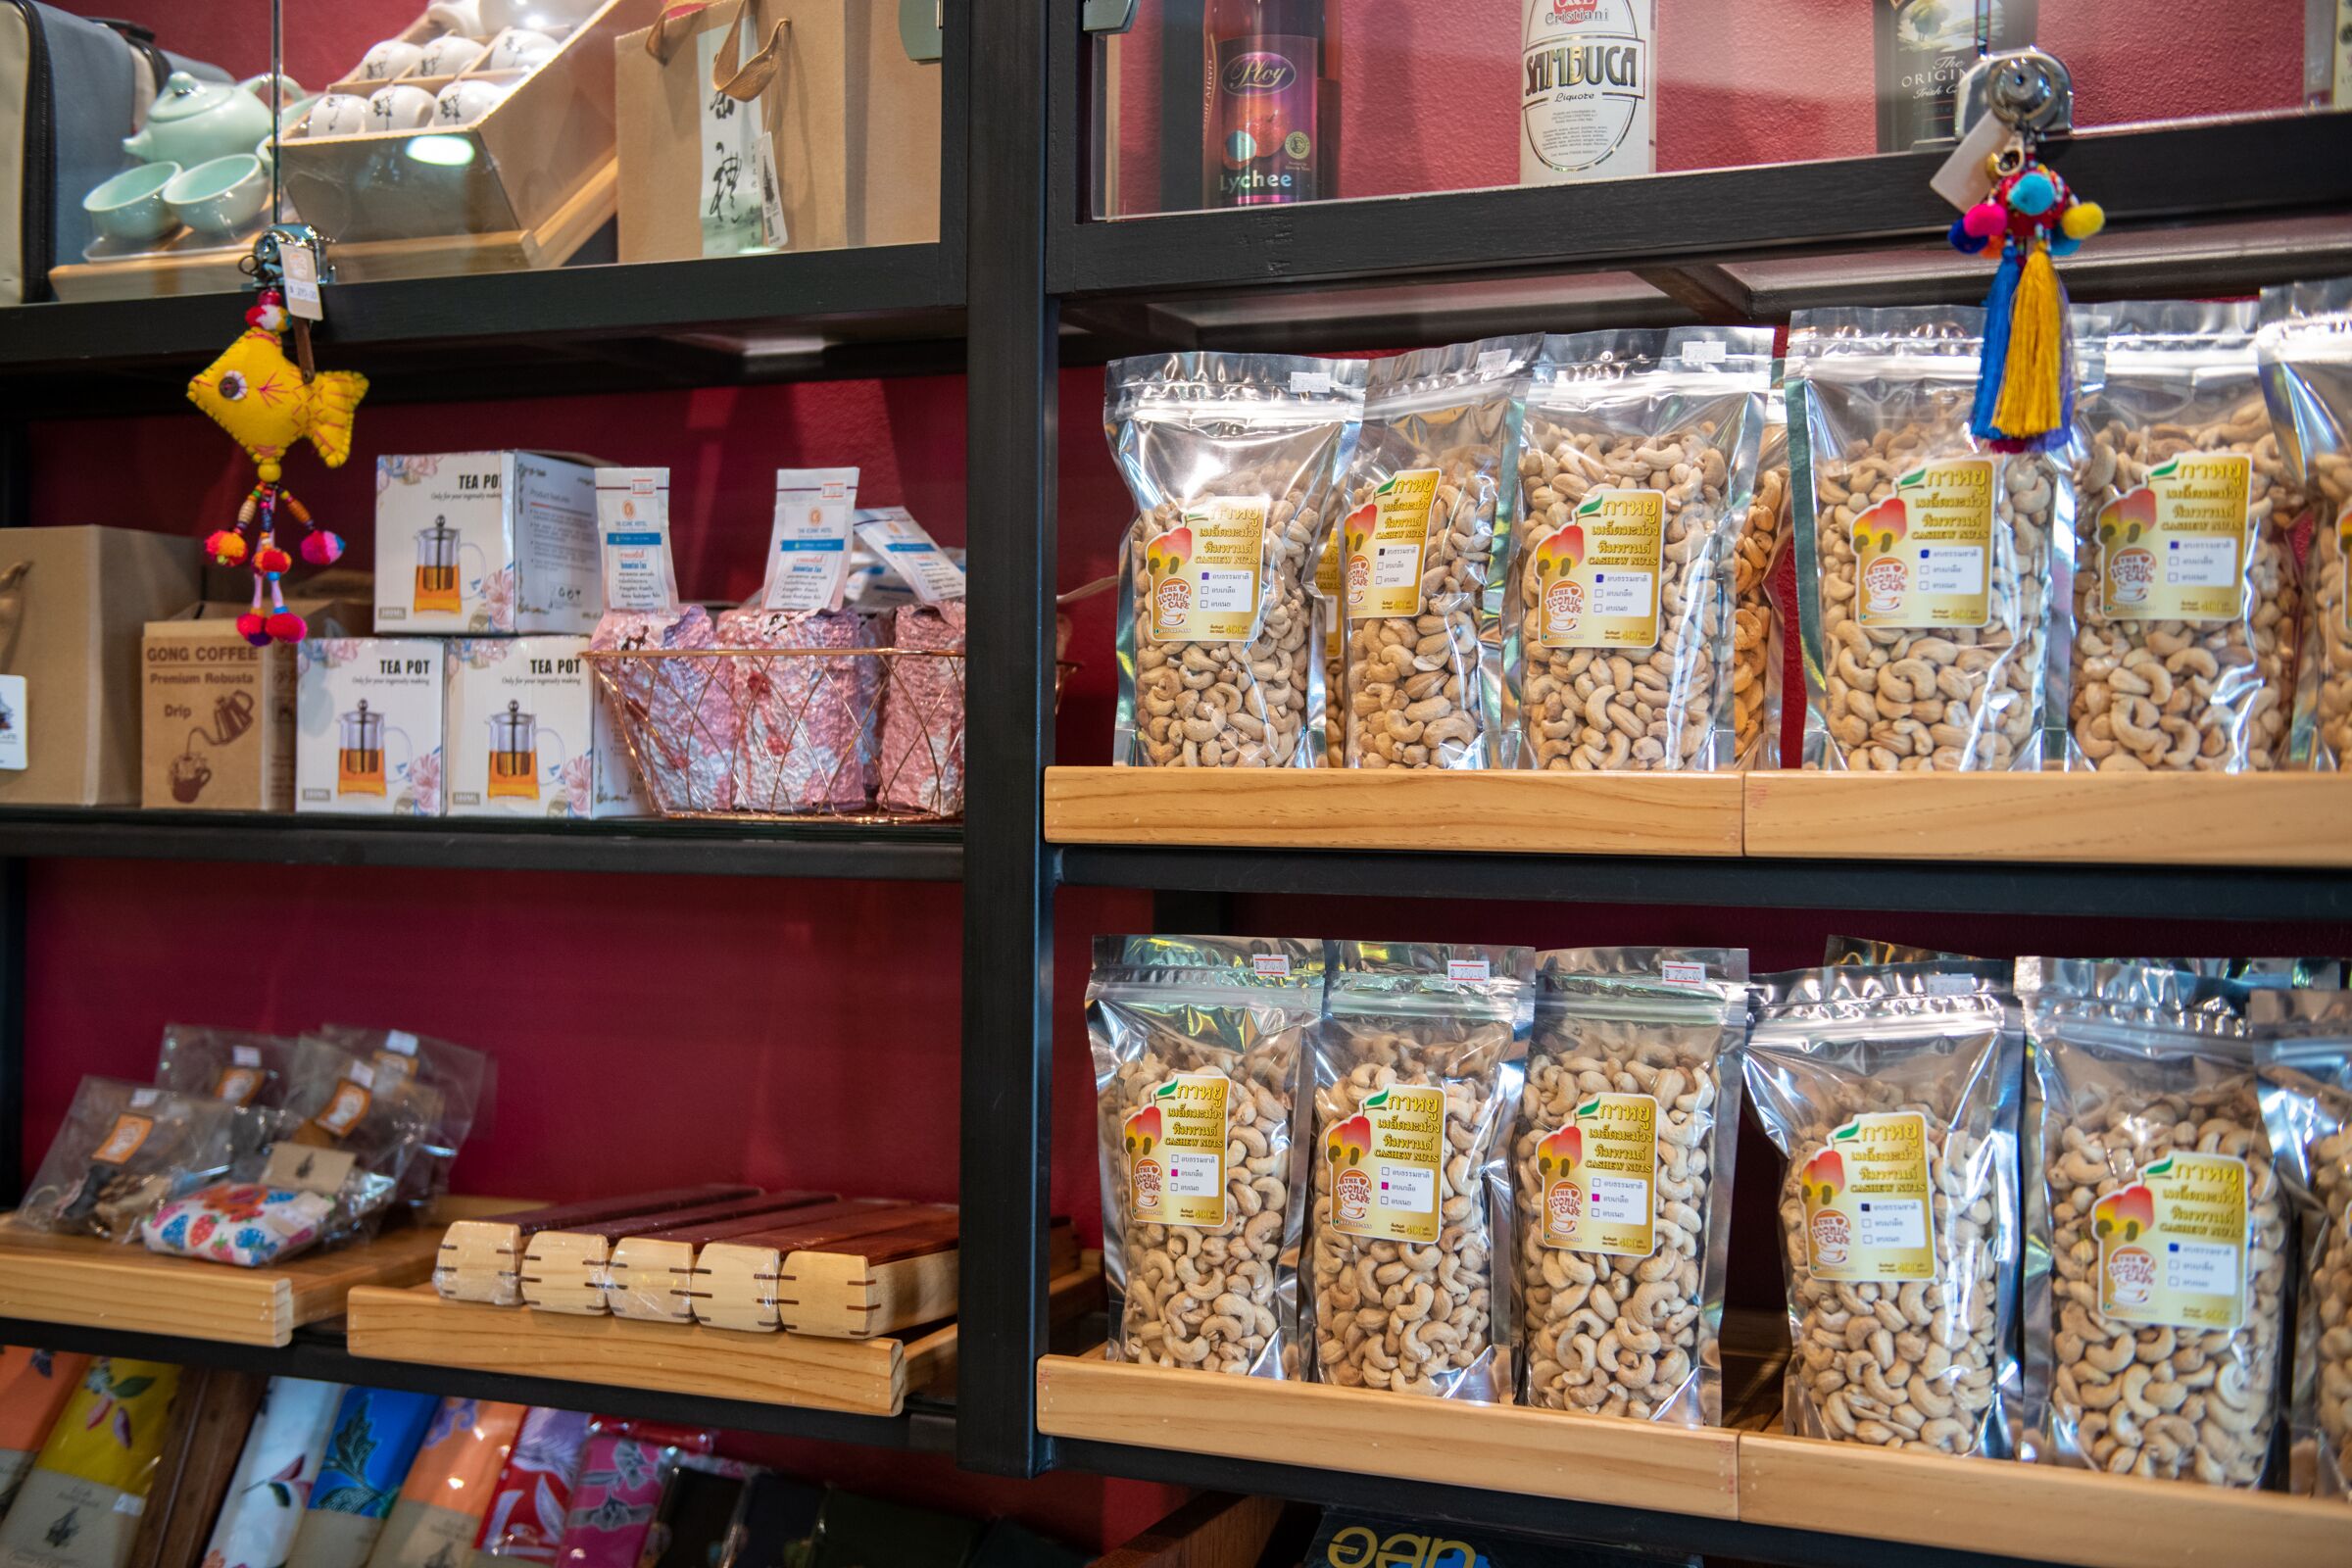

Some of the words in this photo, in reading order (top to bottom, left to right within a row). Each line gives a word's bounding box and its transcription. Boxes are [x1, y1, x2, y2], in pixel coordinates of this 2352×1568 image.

[1545, 8, 1608, 25] Cristiani
[1933, 55, 1964, 70] The
[1230, 55, 1287, 89] Ploy
[1525, 46, 1637, 96] SAMBUCA
[1219, 170, 1292, 194] Lychee
[459, 475, 478, 489] TEA
[1394, 478, 1436, 499] กาหยู
[1928, 468, 1987, 495] กาหยู
[1602, 500, 1658, 523] กาหยู
[1588, 557, 1630, 565] CASHEW
[1631, 557, 1658, 565] NUTS
[1348, 569, 1368, 579] CONIC
[1157, 592, 1190, 606] ICONIC
[1168, 600, 1191, 611] CAFE
[1546, 596, 1582, 610] ICONIC
[1559, 604, 1583, 614] CAFE
[147, 647, 190, 662] GONG
[196, 647, 258, 662] COFFEE
[380, 660, 401, 674] TEA
[407, 660, 430, 674] POT
[530, 659, 552, 674] TEA
[558, 659, 581, 674] POT
[150, 673, 200, 684] Premium
[205, 673, 254, 684] Robusta
[165, 705, 191, 719] Drip
[1176, 1084, 1224, 1107] กาหยู
[1167, 1103, 1224, 1119] เมล็ดมะม่วง
[1389, 1095, 1439, 1121] กาหยู
[1599, 1103, 1650, 1129] กาหยู
[1172, 1122, 1218, 1136] หิมพานต์
[1377, 1115, 1441, 1133] เมล็ดมะม่วง
[1589, 1124, 1653, 1143] เมล็ดมะม่วง
[1862, 1122, 1918, 1147] กาหยู
[1164, 1137, 1200, 1147] CASHEW
[1200, 1138, 1224, 1148] NUTS
[1383, 1134, 1433, 1151] หิมพานต์
[1374, 1150, 1412, 1160] CASHEW
[1413, 1152, 1440, 1162] NUTS
[1585, 1159, 1625, 1171] CASHEW
[1626, 1162, 1652, 1173] NUTS
[1135, 1174, 1160, 1186] ICONIC
[1144, 1182, 1162, 1192] CAFE
[1337, 1185, 1370, 1198] ICONIC
[1349, 1194, 1370, 1204] CAFE
[1548, 1197, 1580, 1210] ICONIC
[1559, 1206, 1582, 1217] CAFE
[1812, 1226, 1849, 1239] ICONIC
